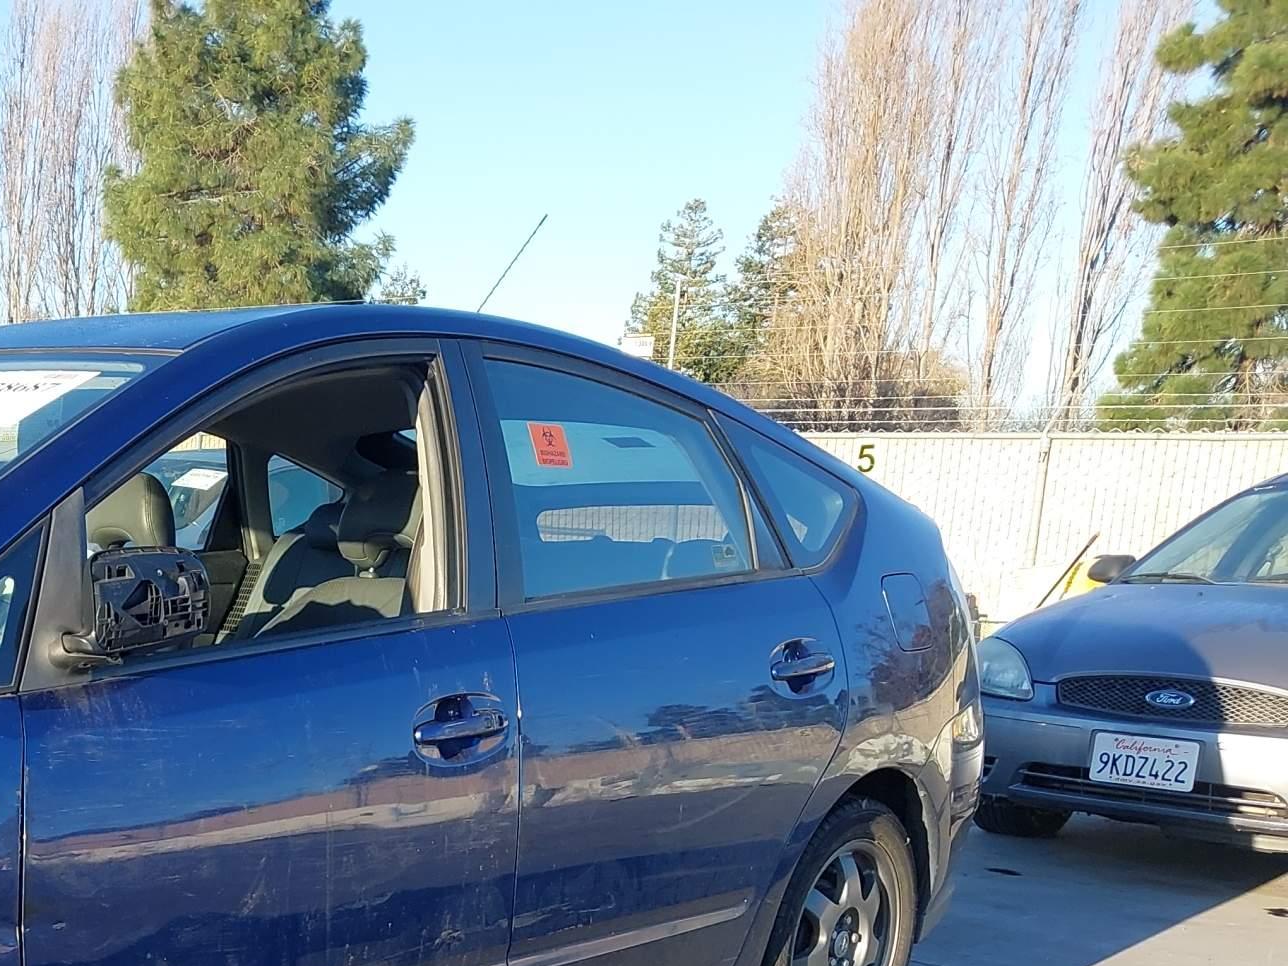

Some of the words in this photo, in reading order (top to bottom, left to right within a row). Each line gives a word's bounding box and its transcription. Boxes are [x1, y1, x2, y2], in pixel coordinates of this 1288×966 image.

[857, 444, 875, 473] 5
[1156, 693, 1183, 705] Ford
[1115, 739, 1177, 756] California
[1096, 752, 1188, 784] 9KDZ422
